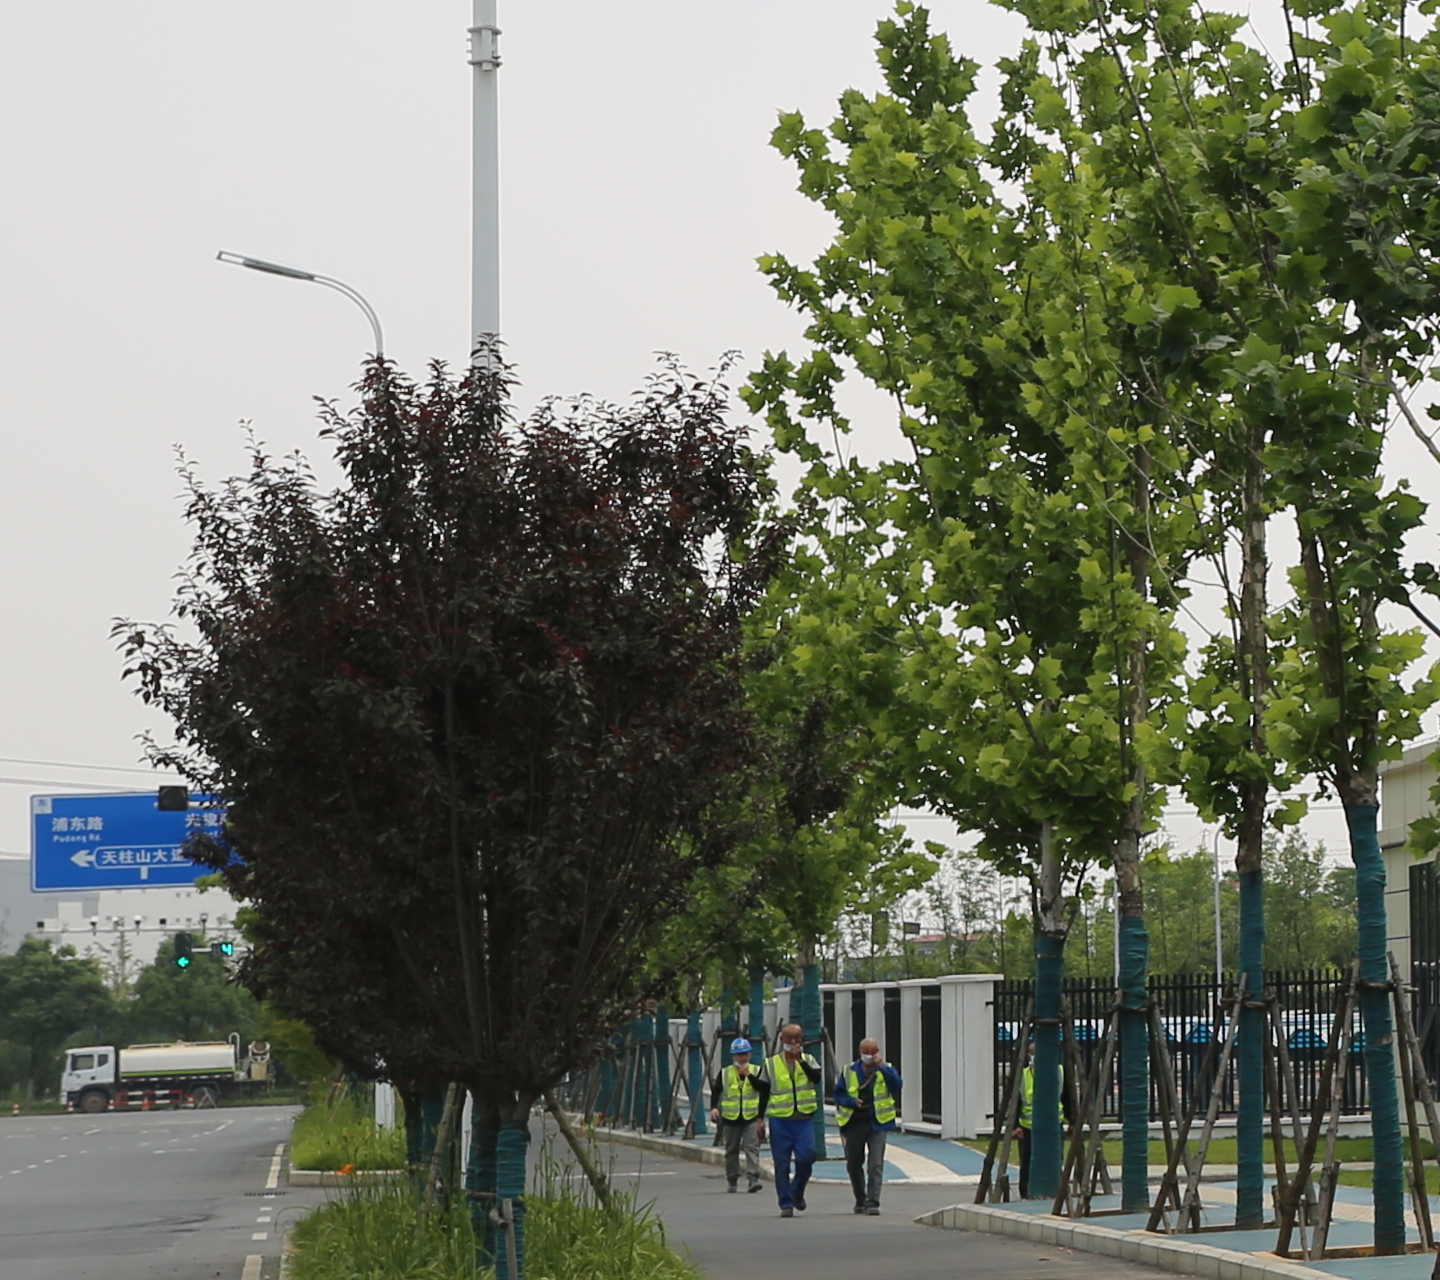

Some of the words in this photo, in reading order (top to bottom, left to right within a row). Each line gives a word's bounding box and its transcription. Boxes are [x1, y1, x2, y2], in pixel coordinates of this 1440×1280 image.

[52, 816, 103, 832] 浦东路
[53, 835, 87, 843] Pudong
